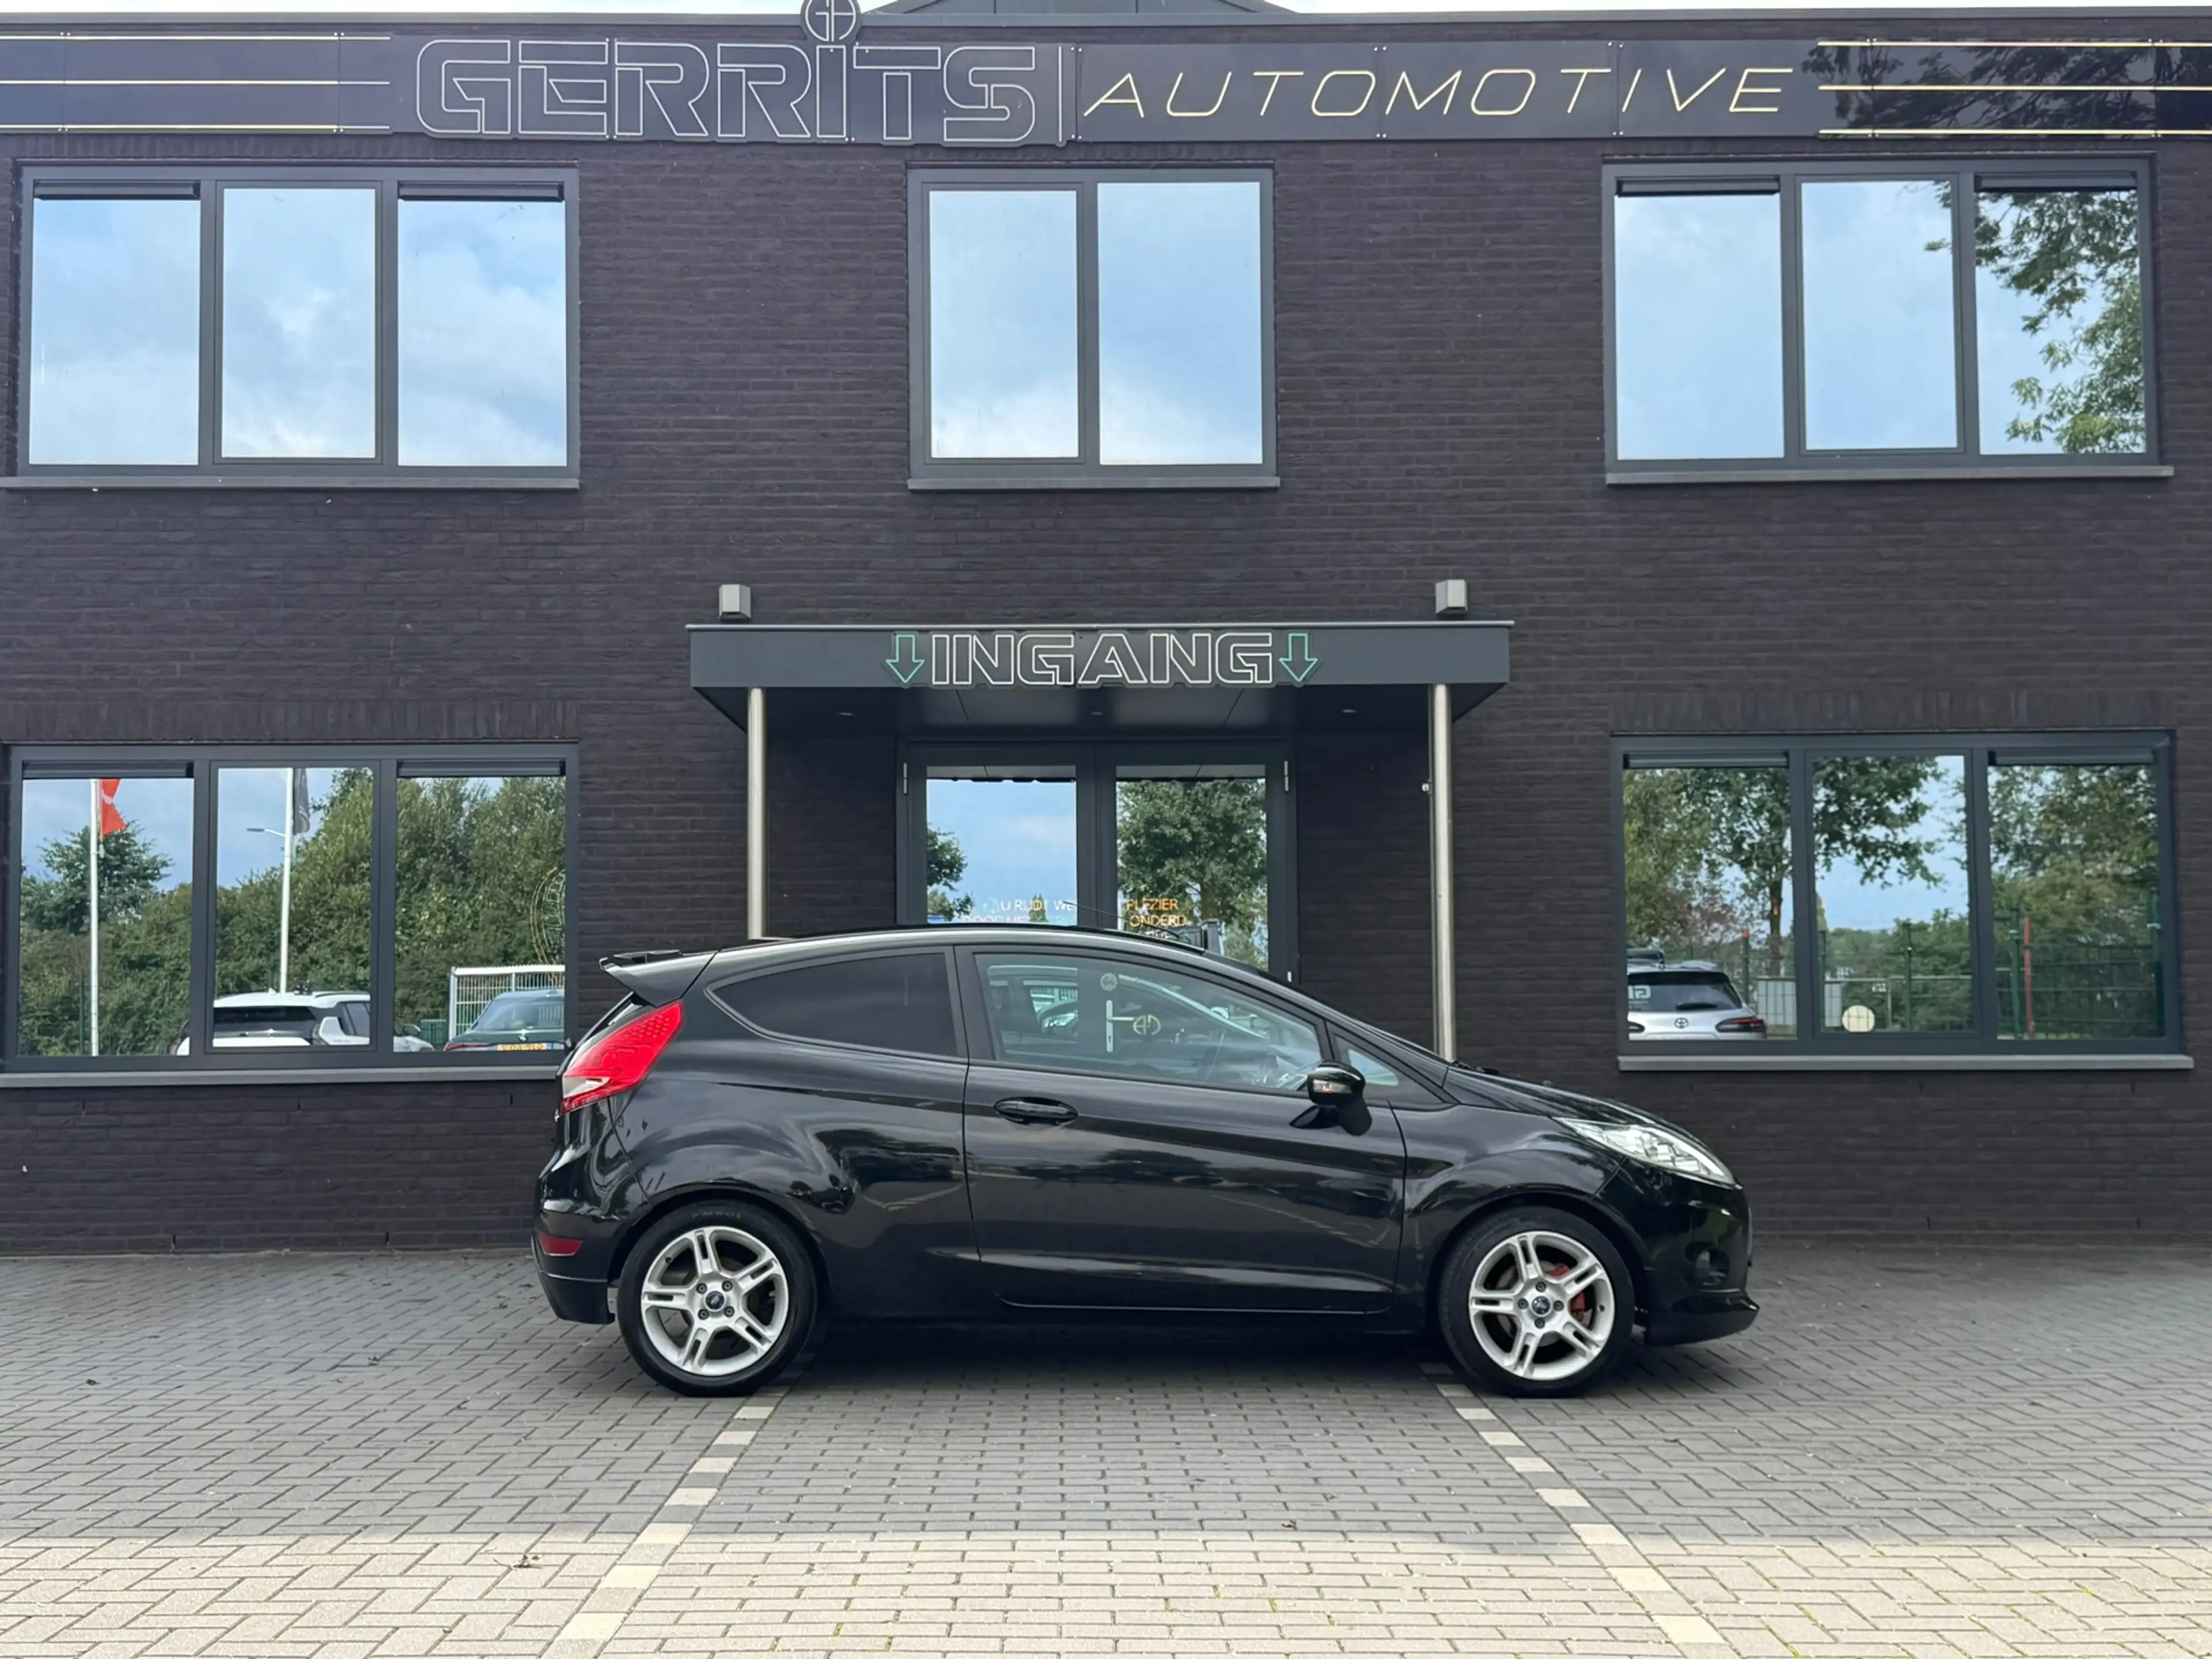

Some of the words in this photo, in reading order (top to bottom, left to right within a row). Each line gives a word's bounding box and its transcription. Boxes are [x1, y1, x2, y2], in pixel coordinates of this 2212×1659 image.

[1083, 67, 1793, 118] AUTOMOTIVE
[931, 632, 1272, 685] INGANG
[1127, 898, 1179, 911] PLEZIER
